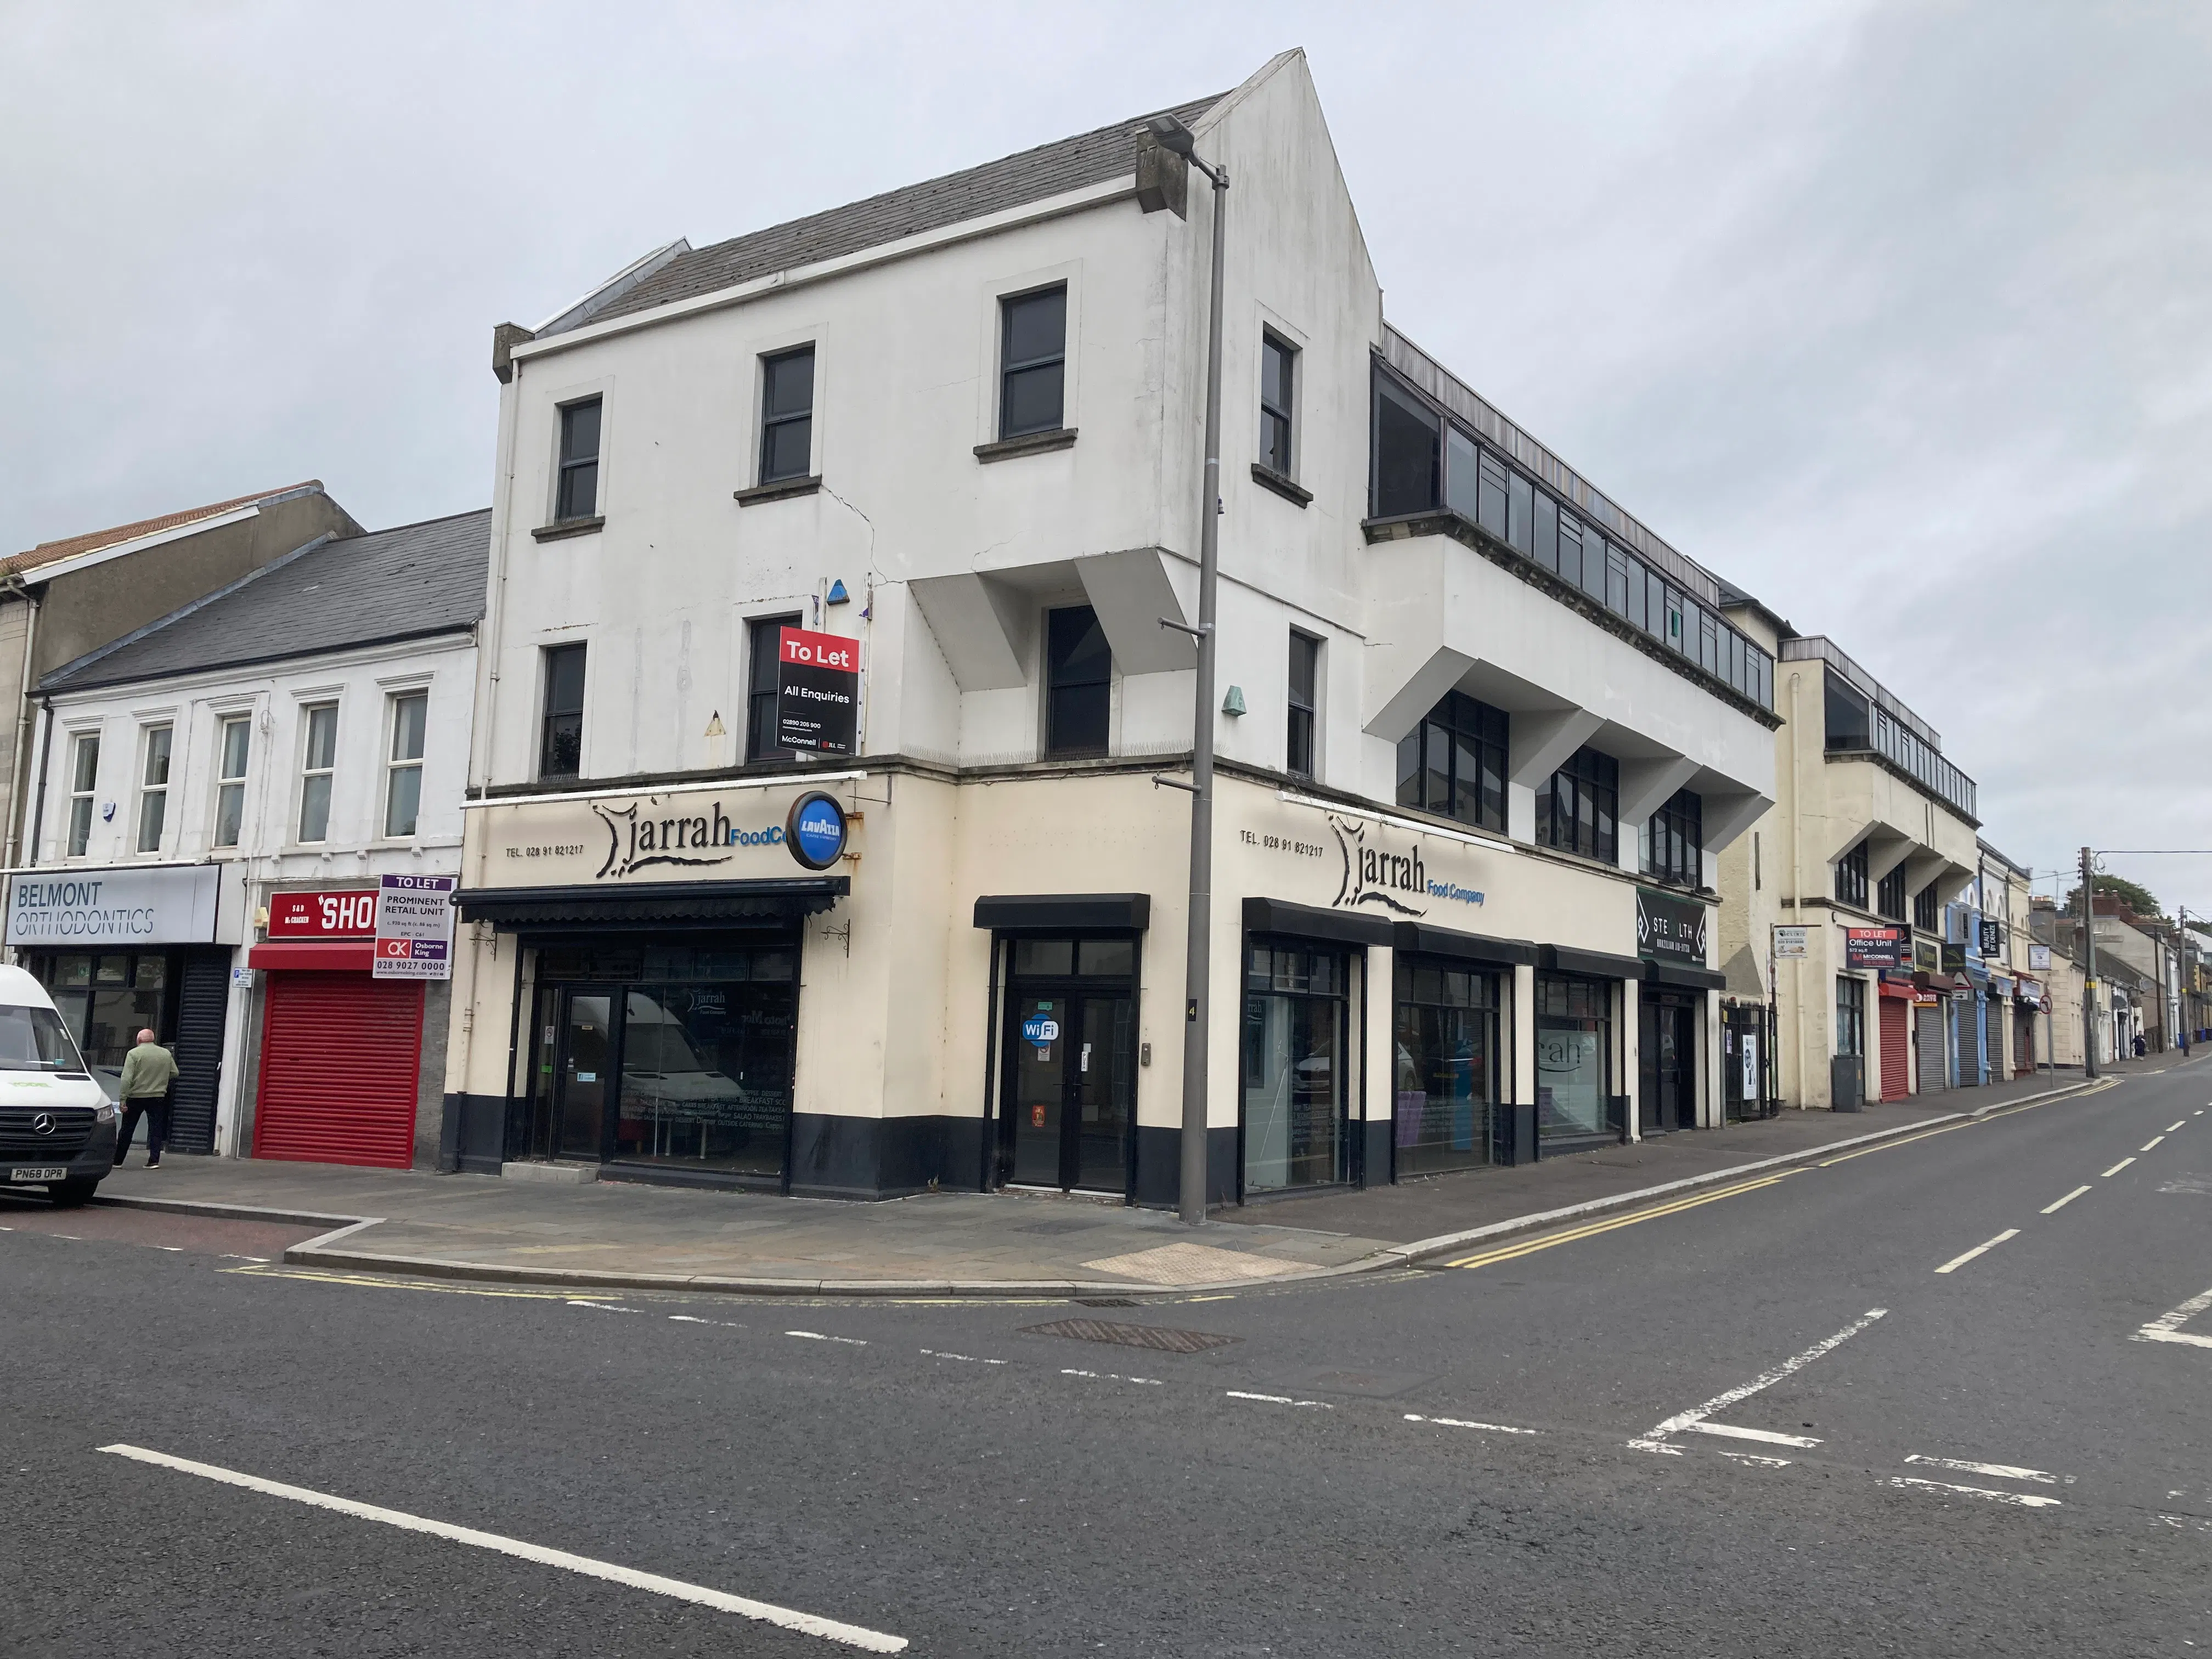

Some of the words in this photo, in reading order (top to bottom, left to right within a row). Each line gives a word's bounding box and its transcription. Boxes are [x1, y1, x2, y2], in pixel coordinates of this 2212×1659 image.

[786, 641, 811, 661] To
[816, 646, 849, 667] Let
[784, 686, 798, 696] All
[801, 687, 849, 704] Enquiries
[782, 735, 816, 746] McConnell
[622, 802, 731, 864] jarrah
[802, 819, 839, 837] LAVAZZA
[1240, 830, 1260, 844] TEL.
[1264, 836, 1279, 848] 028
[1282, 839, 1291, 851] 91
[1295, 842, 1323, 857] 821217
[506, 848, 523, 857] TEL.
[526, 847, 540, 856] 028
[543, 847, 552, 856] 91
[555, 845, 583, 856] 821217
[1355, 845, 1425, 893] jarrah
[396, 877, 413, 887] TO
[416, 878, 439, 889] LET
[18, 882, 102, 907] BELMONT
[1427, 879, 1448, 896] Food
[1449, 883, 1485, 906] Company
[387, 896, 444, 905] PROMINENT
[385, 906, 417, 915] RETAIL
[420, 907, 444, 916] UNIT
[16, 909, 154, 935] ORTHODONTICS
[414, 949, 430, 957] King
[396, 962, 418, 970] 9027
[421, 962, 444, 970] 0000
[697, 992, 725, 1006] jarrah
[1189, 1007, 1195, 1015] 4
[739, 1097, 774, 1105] BREAKFAST
[727, 1104, 757, 1112] AFTERNOON
[733, 1112, 752, 1120] SALAD
[16, 1170, 42, 1178] PN68
